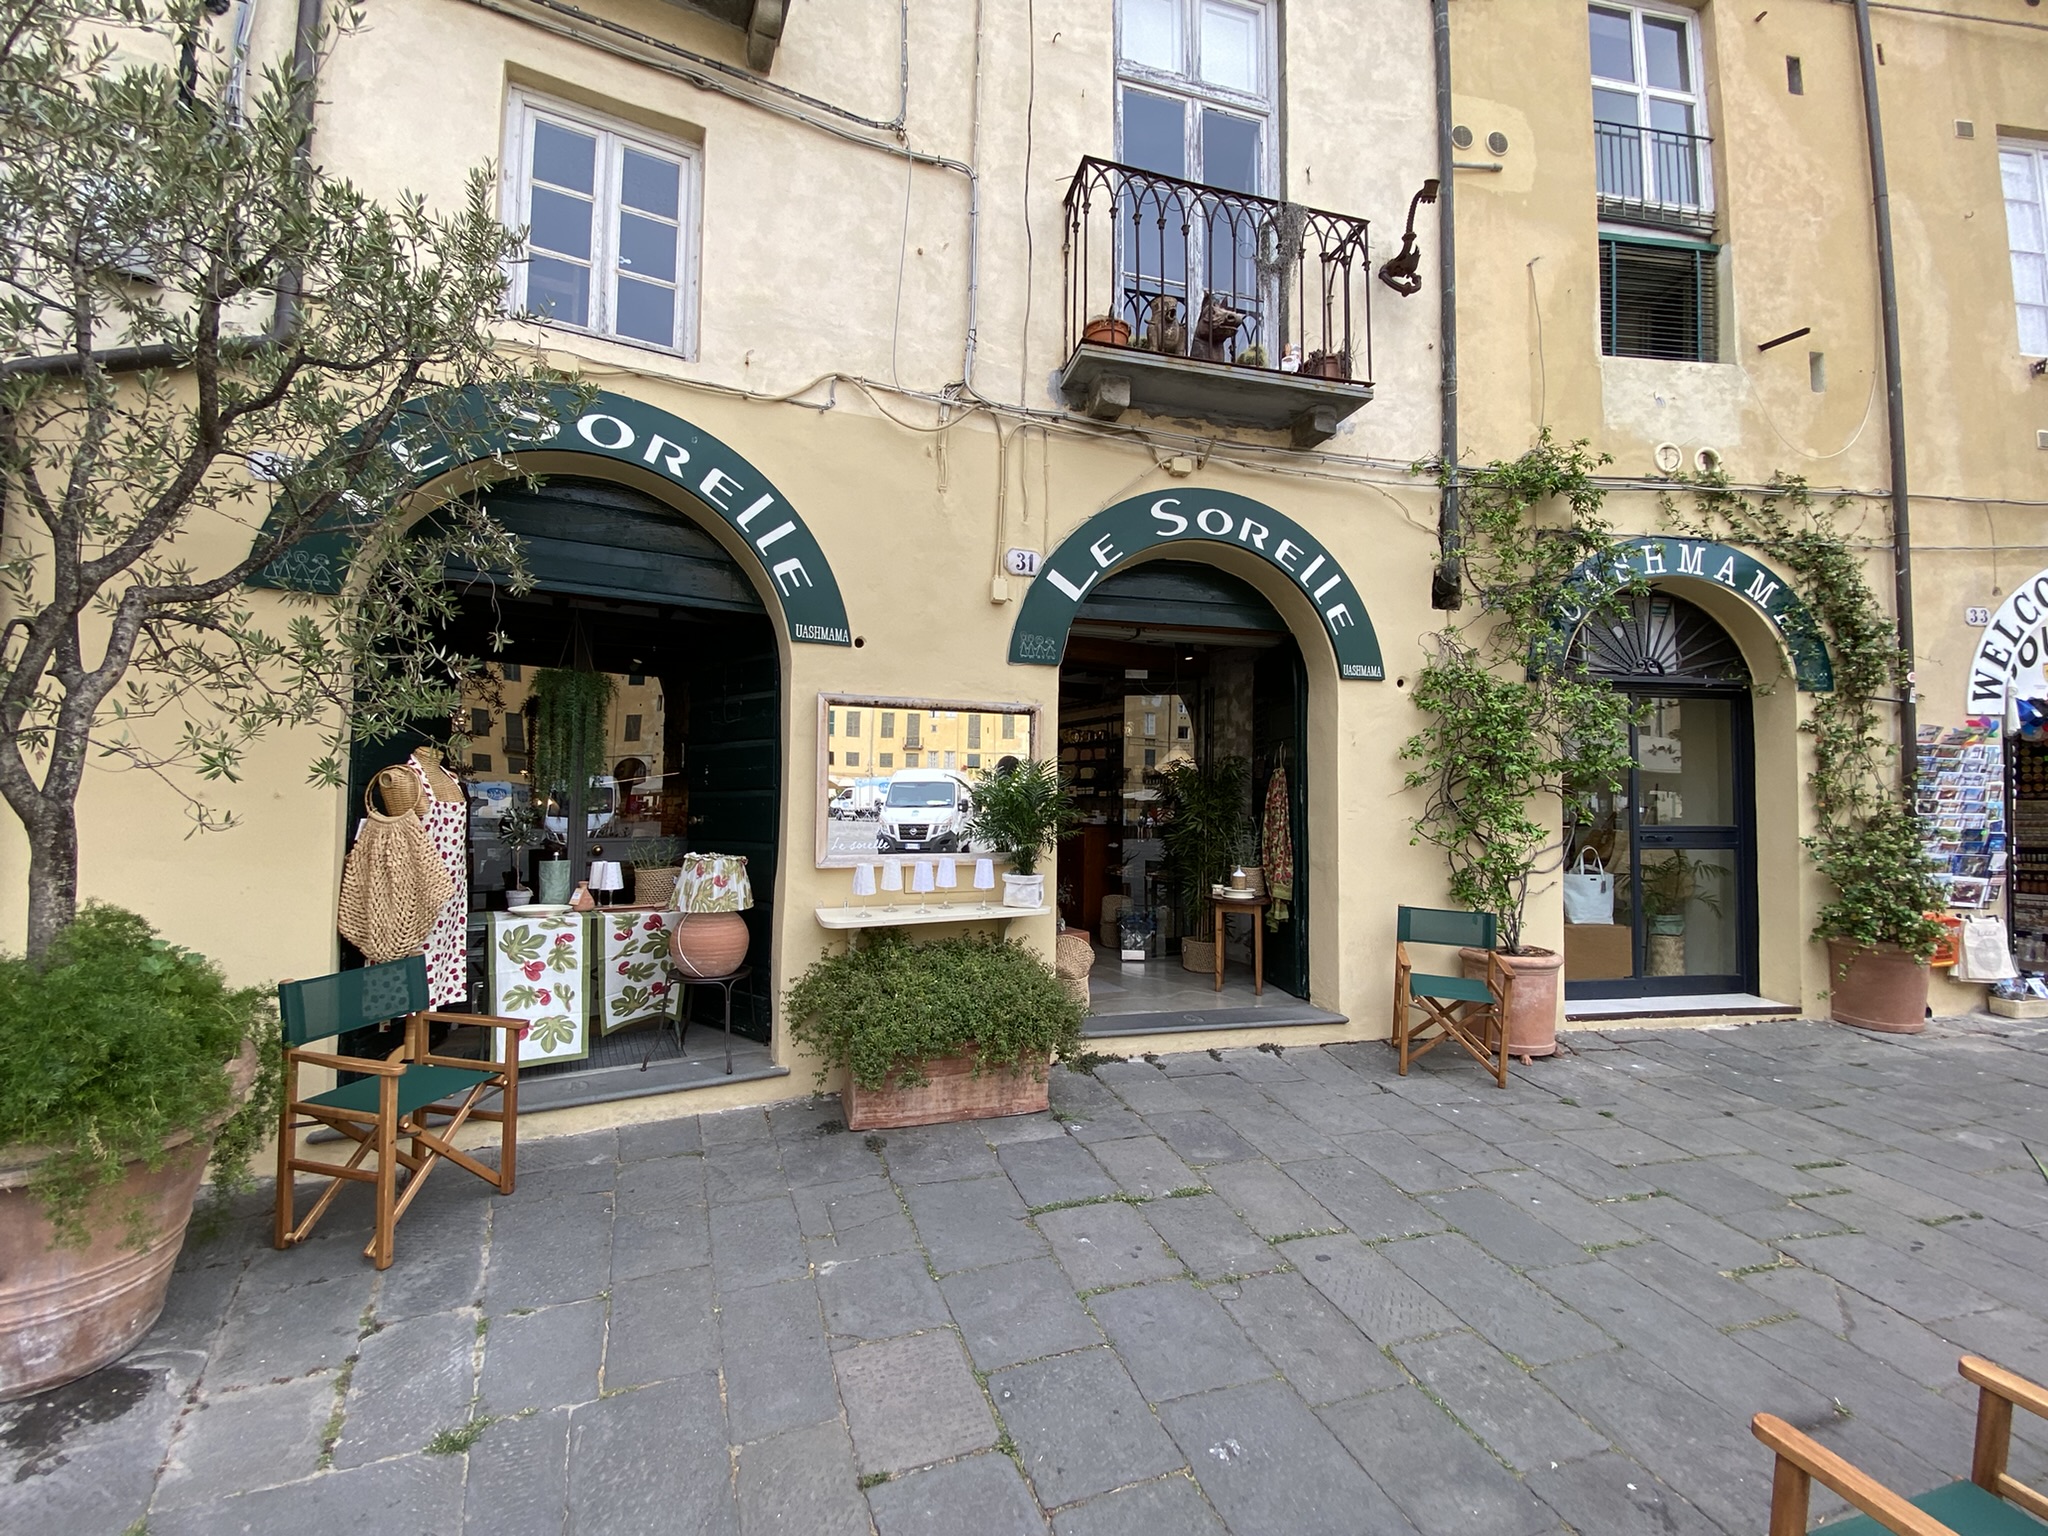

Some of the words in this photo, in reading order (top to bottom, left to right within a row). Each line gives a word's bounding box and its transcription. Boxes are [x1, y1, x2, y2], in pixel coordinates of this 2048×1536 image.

[1016, 552, 1034, 572] 31
[1046, 533, 1123, 602] LE
[1970, 609, 1988, 623] 33
[795, 623, 849, 642] UASHMAMA
[1343, 664, 1382, 677] UASHMAMA
